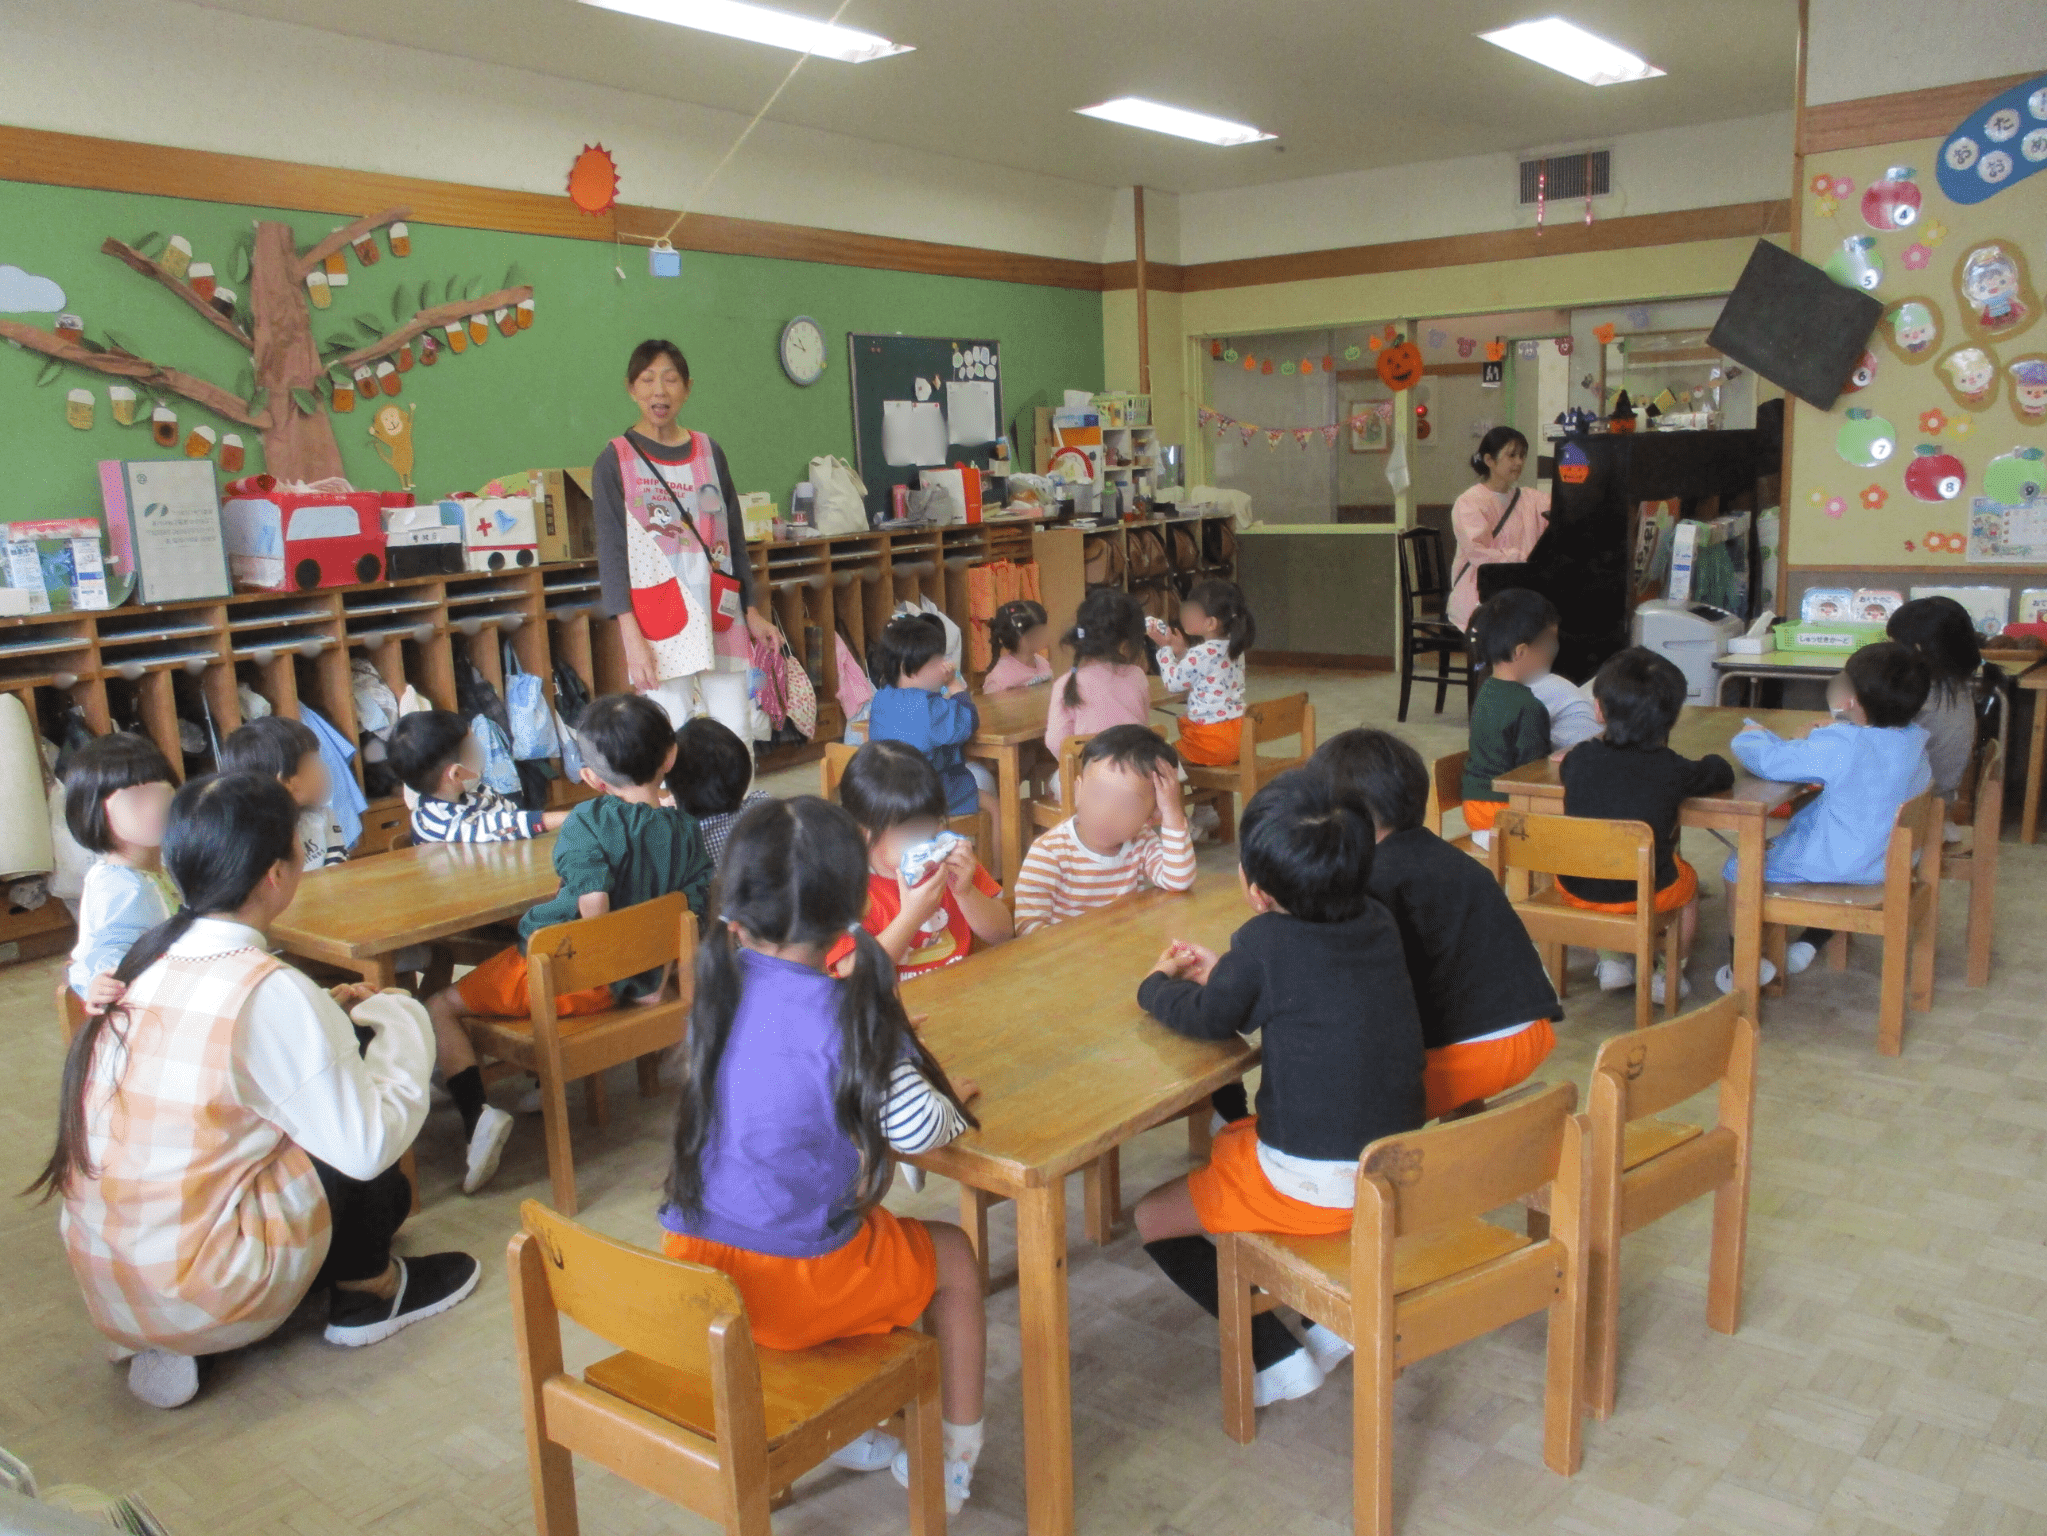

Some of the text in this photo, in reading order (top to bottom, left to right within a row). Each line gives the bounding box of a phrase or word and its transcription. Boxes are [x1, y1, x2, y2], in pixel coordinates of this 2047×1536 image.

[1899, 209, 1907, 219] 4
[1864, 276, 1872, 286] 5
[1858, 371, 1866, 381] 6
[1877, 445, 1886, 455] 7
[655, 487, 685, 498] TROLE
[1945, 482, 1954, 493] 8
[2025, 485, 2034, 496] 9
